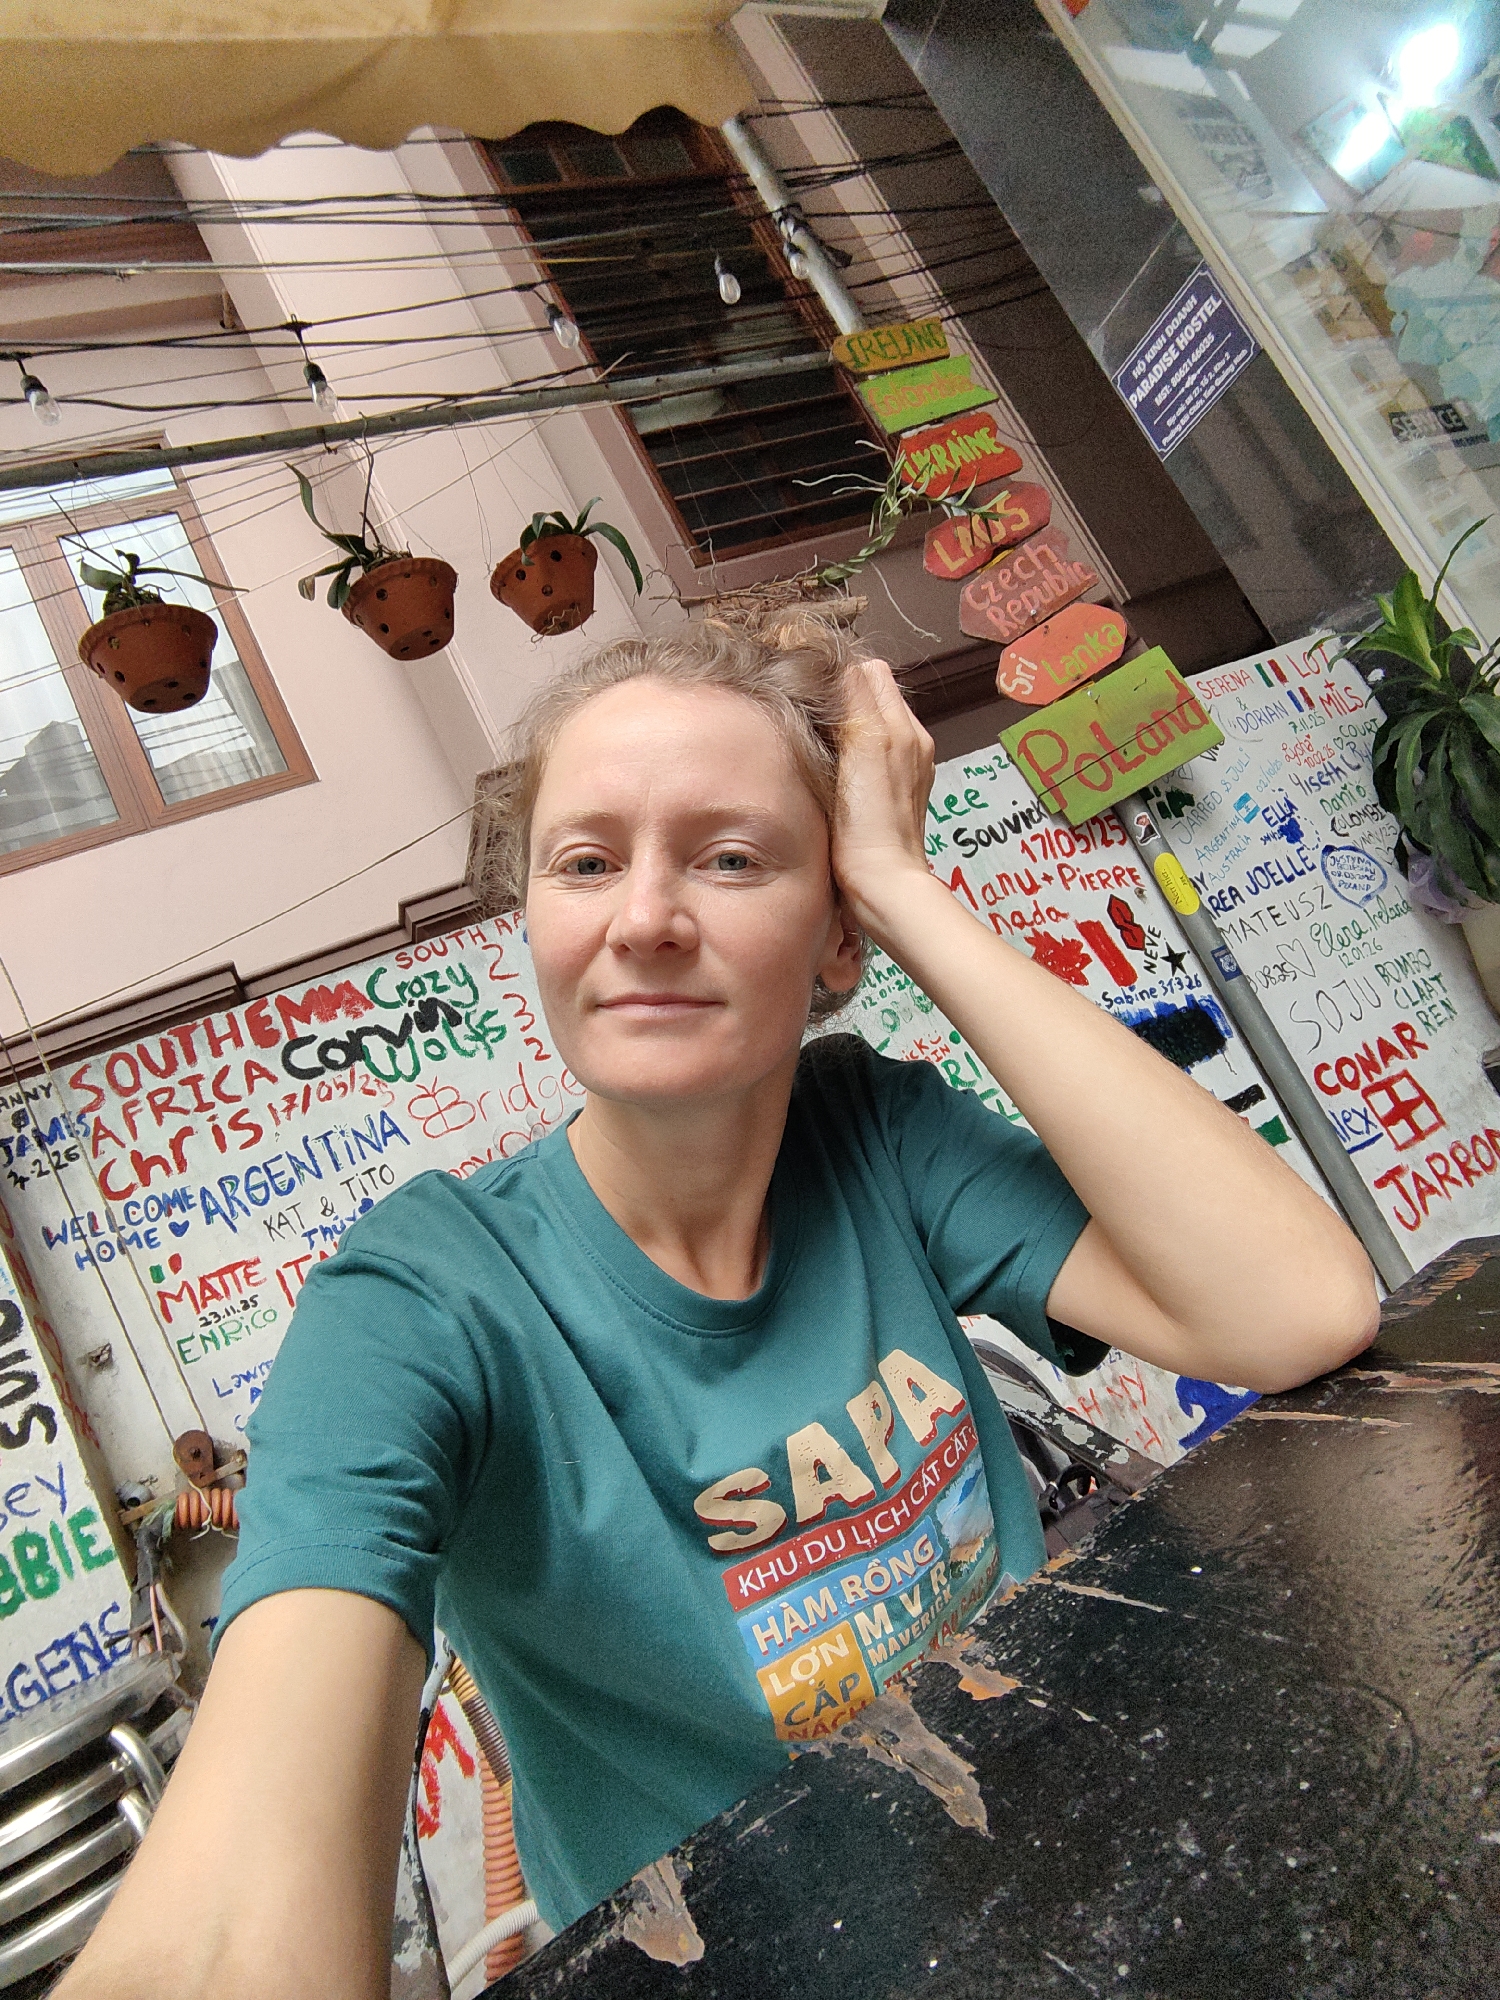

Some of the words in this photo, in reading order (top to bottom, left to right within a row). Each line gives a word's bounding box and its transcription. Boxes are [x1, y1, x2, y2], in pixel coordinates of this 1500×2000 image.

[1128, 343, 1180, 409] PARADISE
[1175, 294, 1222, 350] HOSTEL
[1144, 334, 1168, 362] KINH
[1164, 294, 1198, 338] DOANH
[964, 543, 1058, 611] Czech
[986, 561, 1098, 637] Republic
[999, 652, 1038, 695] Sri
[1041, 623, 1125, 685] Lanka
[1196, 669, 1255, 701] SERENA
[1235, 700, 1290, 735] DORIAN
[926, 788, 989, 824] Lee
[1208, 888, 1246, 921] REA
[1245, 846, 1318, 896] JOELLE
[1218, 885, 1333, 949] MATEUSZ
[395, 926, 487, 970] SOUTH
[1102, 983, 1158, 1010] Sabine
[1290, 976, 1382, 1055] SOJU
[1313, 1021, 1430, 1096] CONAR
[91, 1059, 279, 1159] AFRICA
[98, 1108, 263, 1201] Chris
[74, 1226, 162, 1271] HOME
[263, 1201, 306, 1242] KAT
[320, 1196, 335, 1218] &
[157, 1256, 267, 1324] MATTE
[694, 1349, 966, 1555] SAPA
[738, 1548, 800, 1597] KHU
[803, 1528, 847, 1567] DU
[752, 1586, 840, 1657] HÀM
[868, 1584, 954, 1667] MAVERICK
